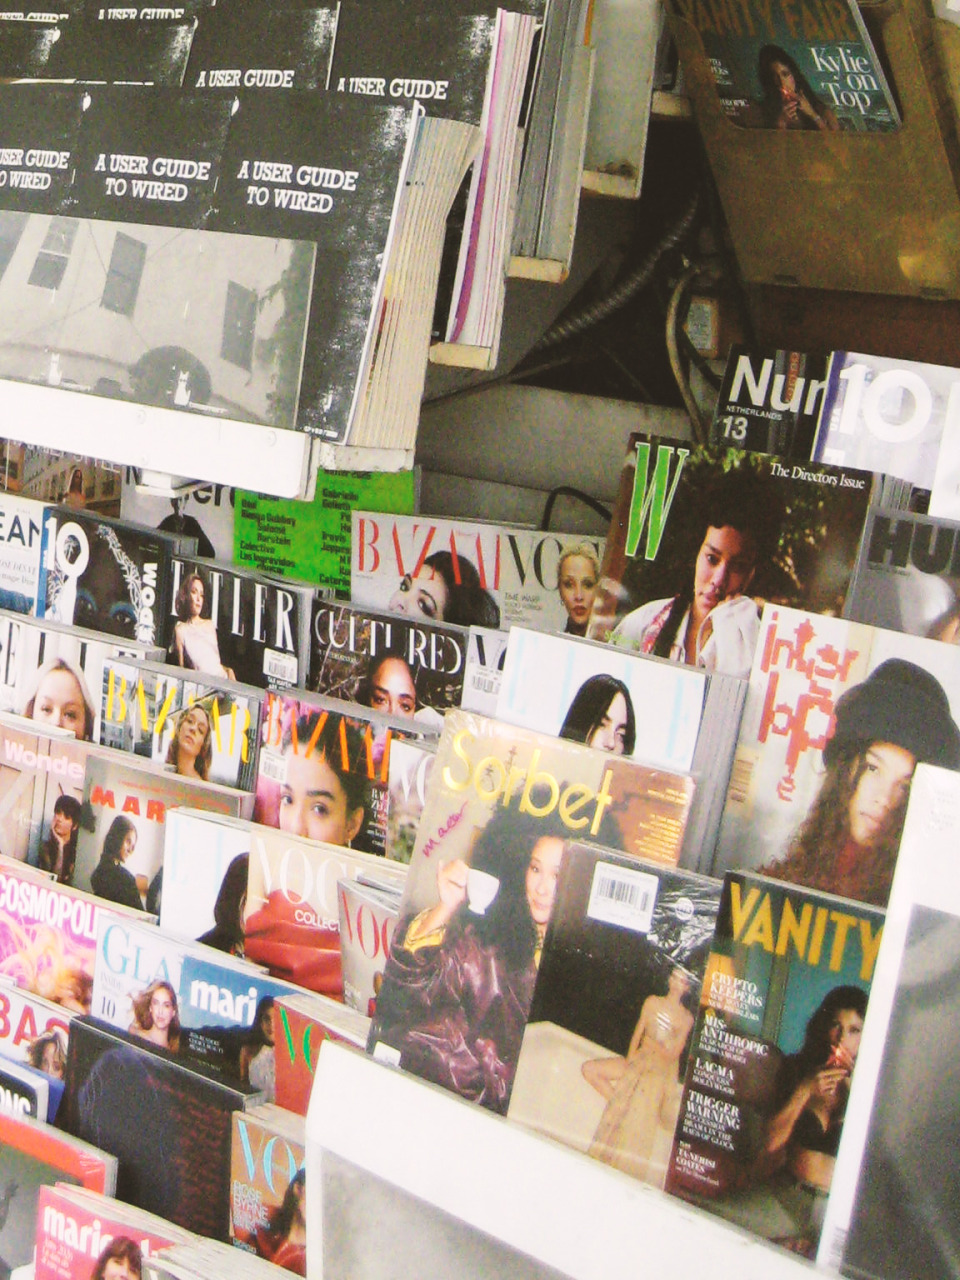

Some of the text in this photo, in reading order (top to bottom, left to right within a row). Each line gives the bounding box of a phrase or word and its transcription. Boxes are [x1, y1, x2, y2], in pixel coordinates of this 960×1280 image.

[809, 46, 872, 80] Kylie
[195, 70, 295, 88] A USER GUIDE
[390, 79, 448, 100] GUIDE
[846, 73, 880, 92] on
[821, 81, 871, 115] Top
[25, 151, 70, 170] GUIDE
[95, 154, 211, 181] A USER GUIDE
[7, 171, 51, 190] WIRED
[237, 161, 359, 191] A USER GUIDE
[106, 178, 188, 202] TO WIRED
[246, 186, 333, 214] TO WIRED
[726, 404, 783, 421] NETHERLANDS
[722, 416, 748, 441] 13
[770, 462, 866, 490] The Directors Issue
[625, 441, 690, 561] W
[314, 608, 463, 675] CULTURED
[5, 739, 83, 780] Wonde
[443, 727, 614, 836] Sorbet
[730, 881, 886, 982] VANITY
[710, 982, 763, 1007] KEEPERS
[712, 971, 757, 994] CRYPTO
[703, 1025, 769, 1056] ANTHROPIC
[696, 1057, 734, 1080] LACMA
[689, 1089, 740, 1118] TRIGGER
